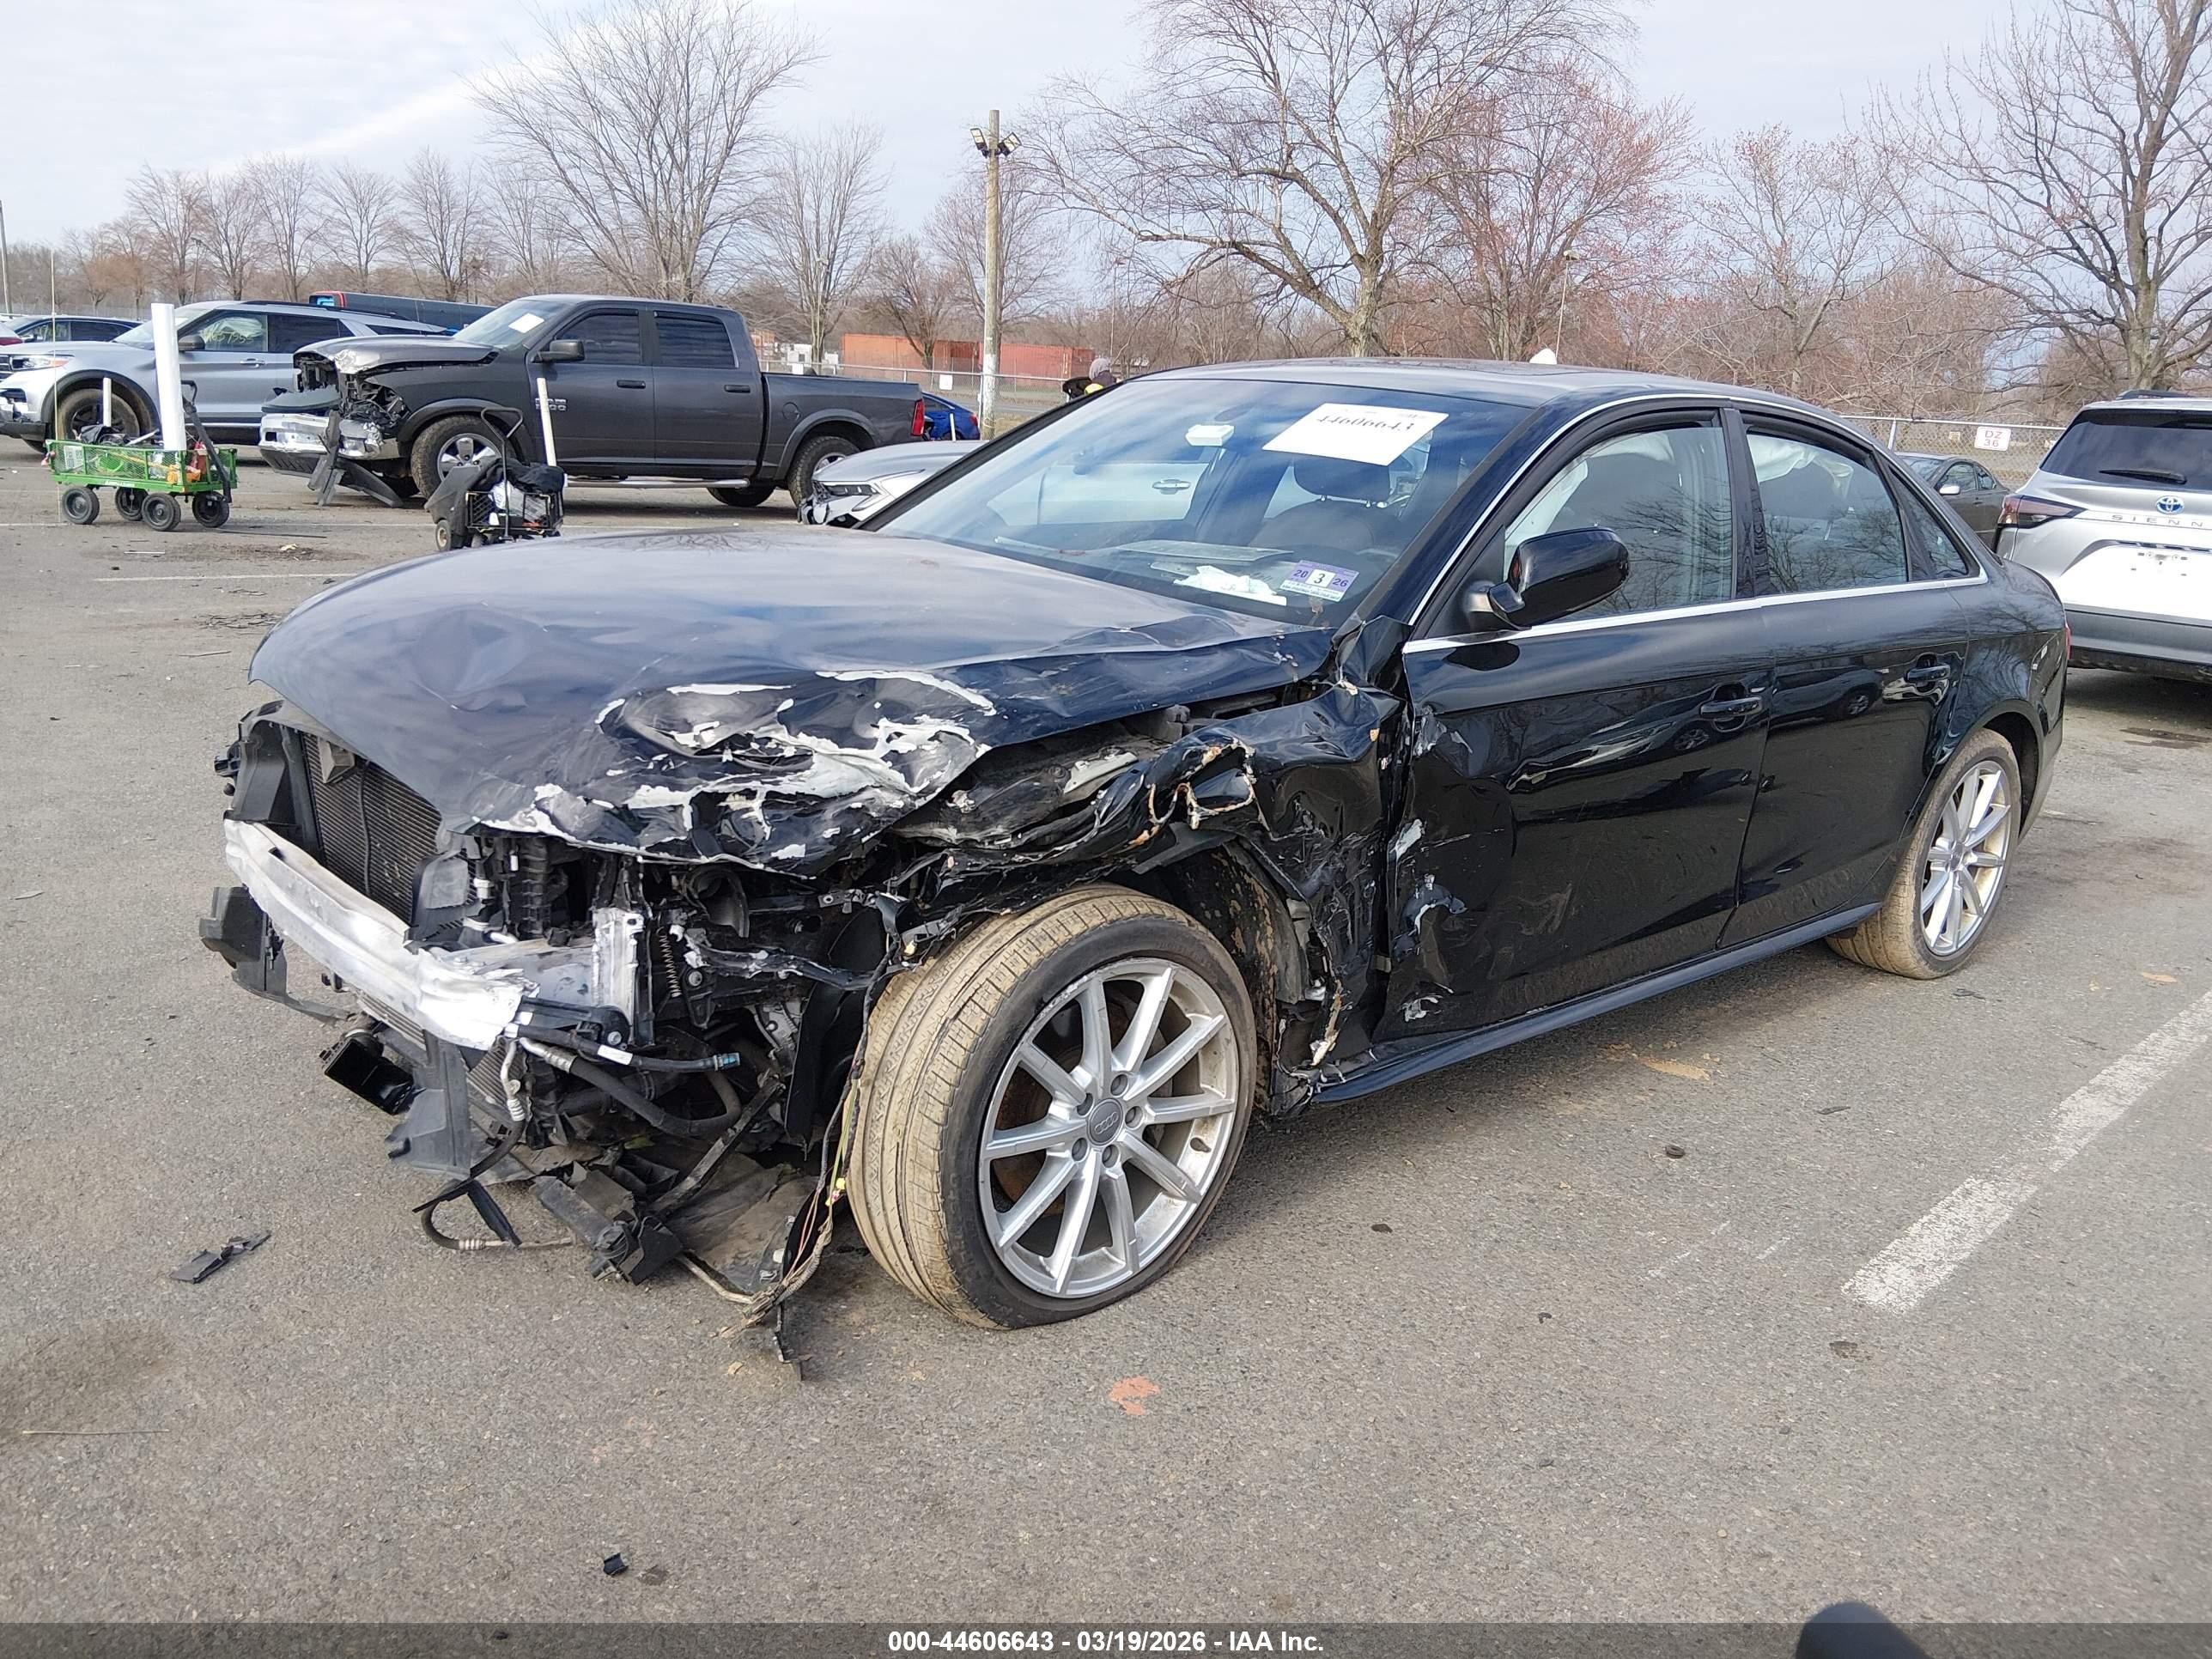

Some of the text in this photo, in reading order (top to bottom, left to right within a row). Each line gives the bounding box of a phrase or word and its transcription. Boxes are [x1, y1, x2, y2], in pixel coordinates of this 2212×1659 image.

[1984, 429, 2002, 439] DZ
[1293, 569, 1349, 587] 20 3 26
